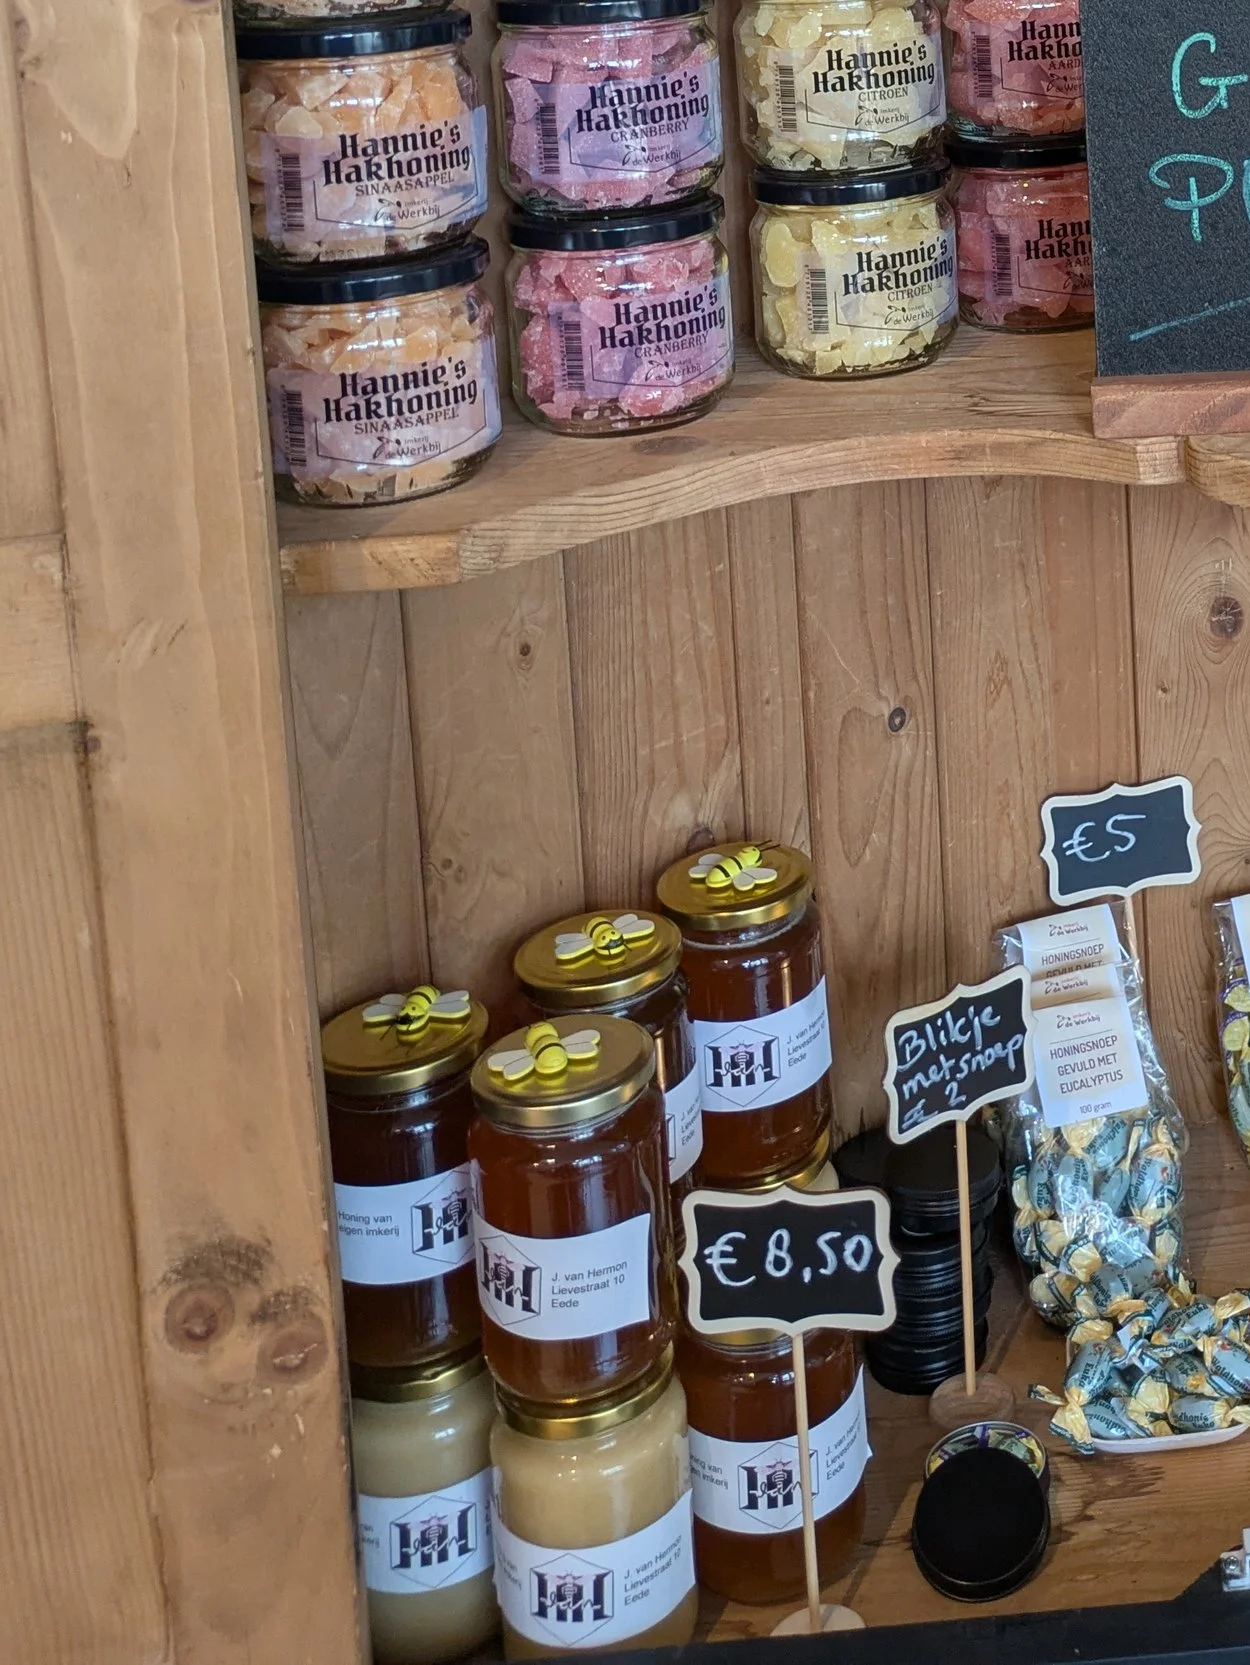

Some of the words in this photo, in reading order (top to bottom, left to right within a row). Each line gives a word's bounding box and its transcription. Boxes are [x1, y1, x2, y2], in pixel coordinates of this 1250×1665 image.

[825, 39, 927, 74] Hannie's
[588, 70, 700, 111] Hannie's
[812, 61, 936, 95] Hakhoning
[858, 86, 909, 102] CITROEN
[575, 93, 710, 134] Hakhoning
[338, 120, 462, 160] Hannie's
[610, 118, 690, 144] CRANBERRY
[321, 144, 472, 187] Hakhoning
[354, 172, 456, 198] SINAASAPPEL
[1062, 812, 1147, 863] €5
[897, 1005, 1001, 1073] Blikje
[1049, 1034, 1119, 1061] HONINGSNOEP
[1057, 1057, 1097, 1077] GEVULD
[1097, 1051, 1118, 1069] MET
[1060, 1069, 1124, 1095] EUCALYPTUS
[365, 1224, 400, 1237] imkerij
[373, 1215, 393, 1223] van
[551, 1271, 561, 1282] J.
[564, 1271, 585, 1282] van
[587, 1260, 628, 1278] Hermon
[550, 1279, 610, 1296] Lievestraat
[613, 1273, 626, 1285] 10
[550, 1298, 580, 1309] Eede
